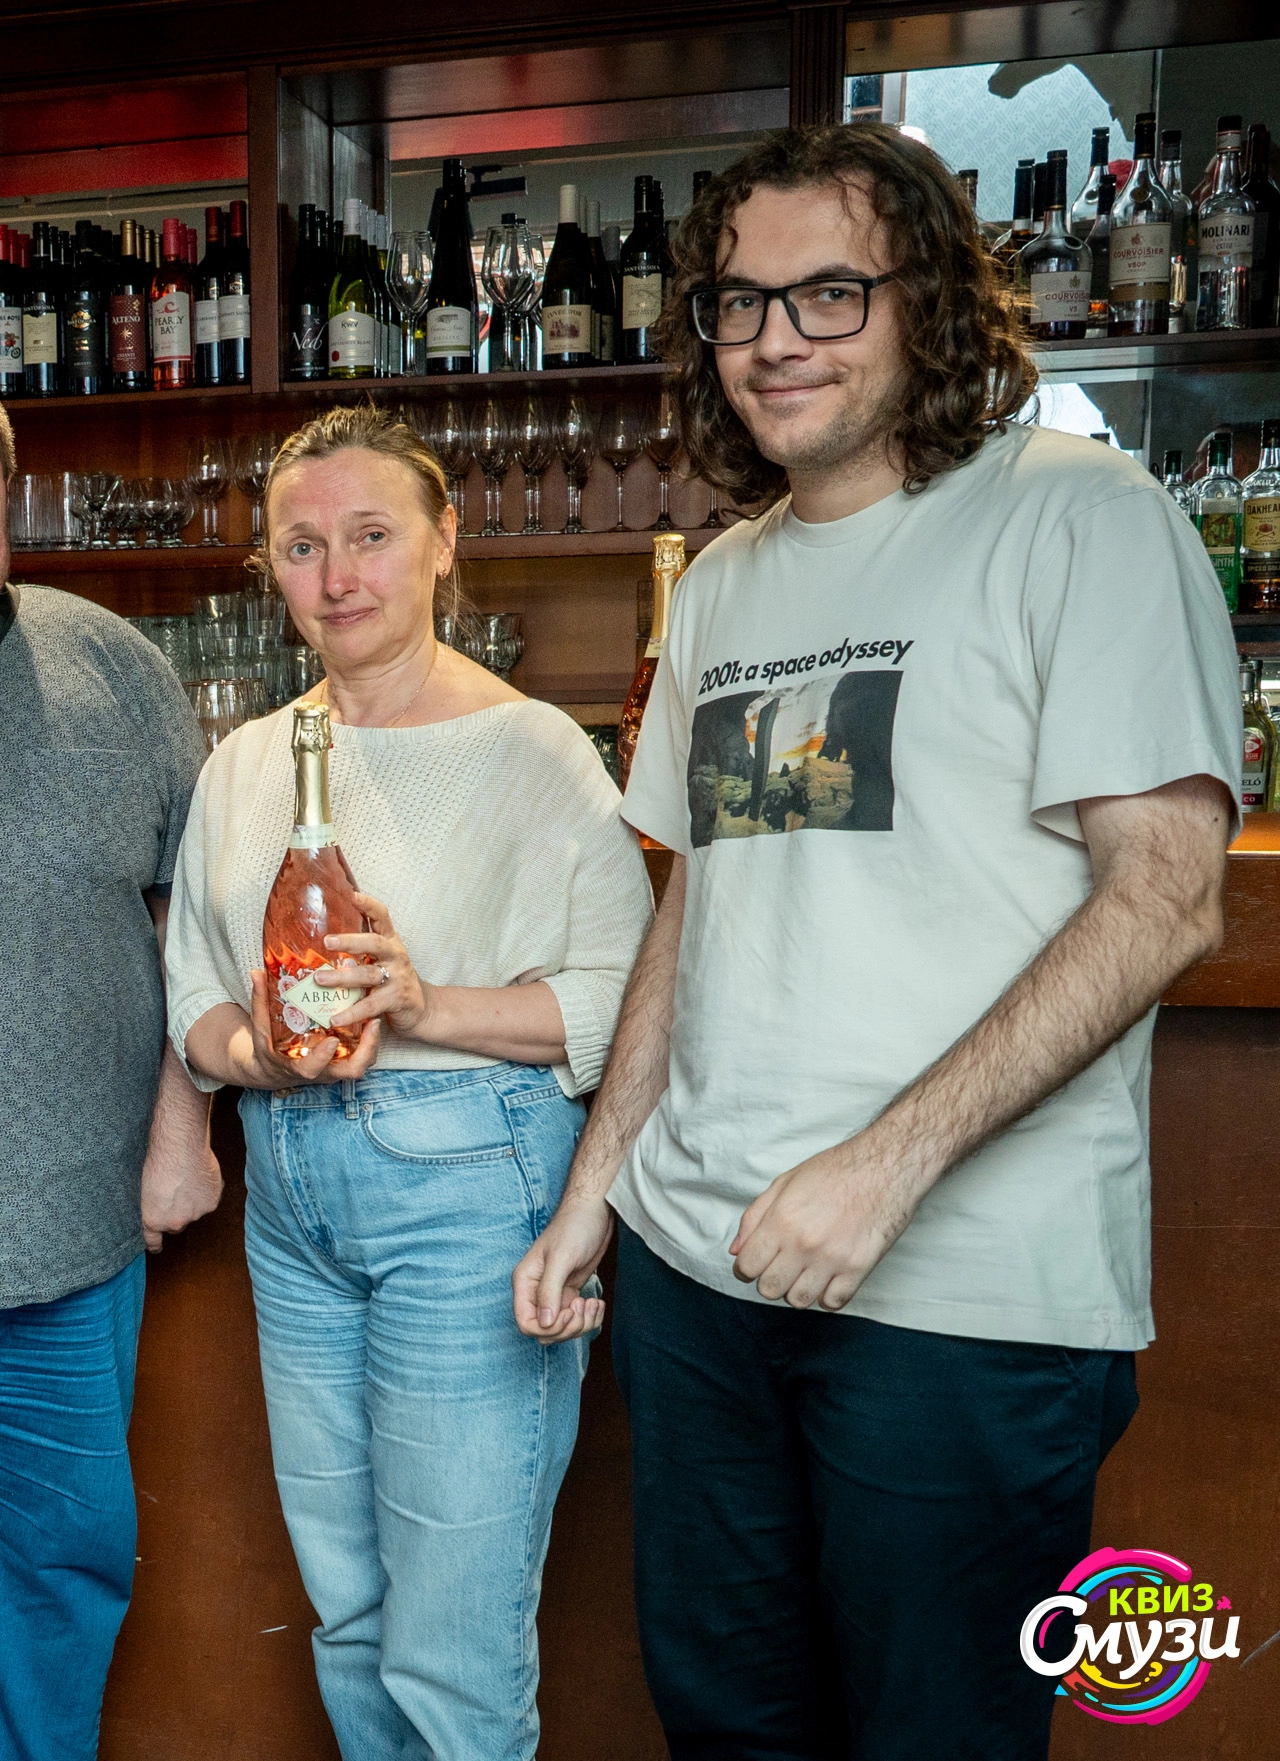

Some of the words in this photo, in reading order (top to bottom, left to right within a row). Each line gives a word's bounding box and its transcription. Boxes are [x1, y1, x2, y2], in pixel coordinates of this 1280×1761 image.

[1202, 225, 1250, 238] MOLINARI
[1113, 248, 1164, 258] COURVOISIER
[112, 316, 140, 325] ALTENO
[155, 316, 184, 326] PEARLY
[160, 326, 176, 334] BAY
[698, 660, 742, 696] 2001:
[745, 664, 758, 681] a
[760, 654, 817, 684] space
[818, 637, 914, 668] odyssey
[301, 988, 350, 1003] ABRAU
